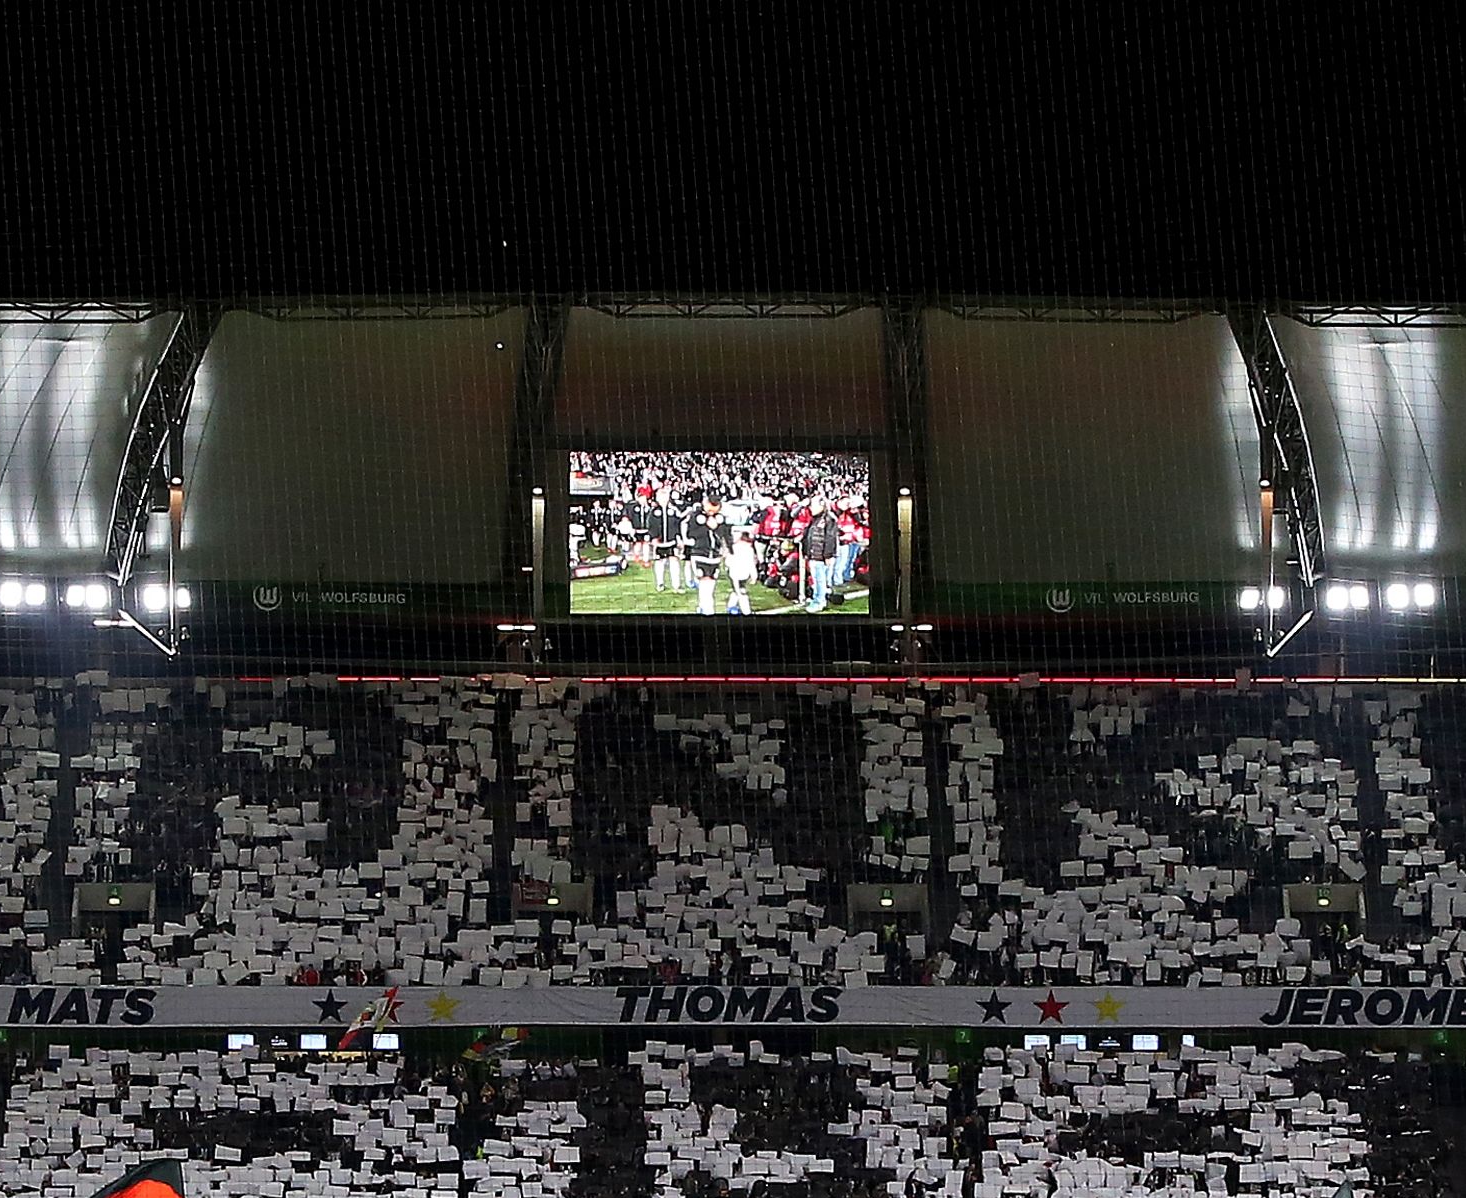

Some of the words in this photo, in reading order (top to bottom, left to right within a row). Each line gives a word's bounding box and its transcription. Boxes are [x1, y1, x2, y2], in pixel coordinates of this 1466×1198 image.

[320, 591, 406, 604] WOLFSBURG
[1112, 592, 1200, 604] WOLFSBURG
[7, 988, 157, 1025] MATS
[616, 986, 843, 1023] THOMAS
